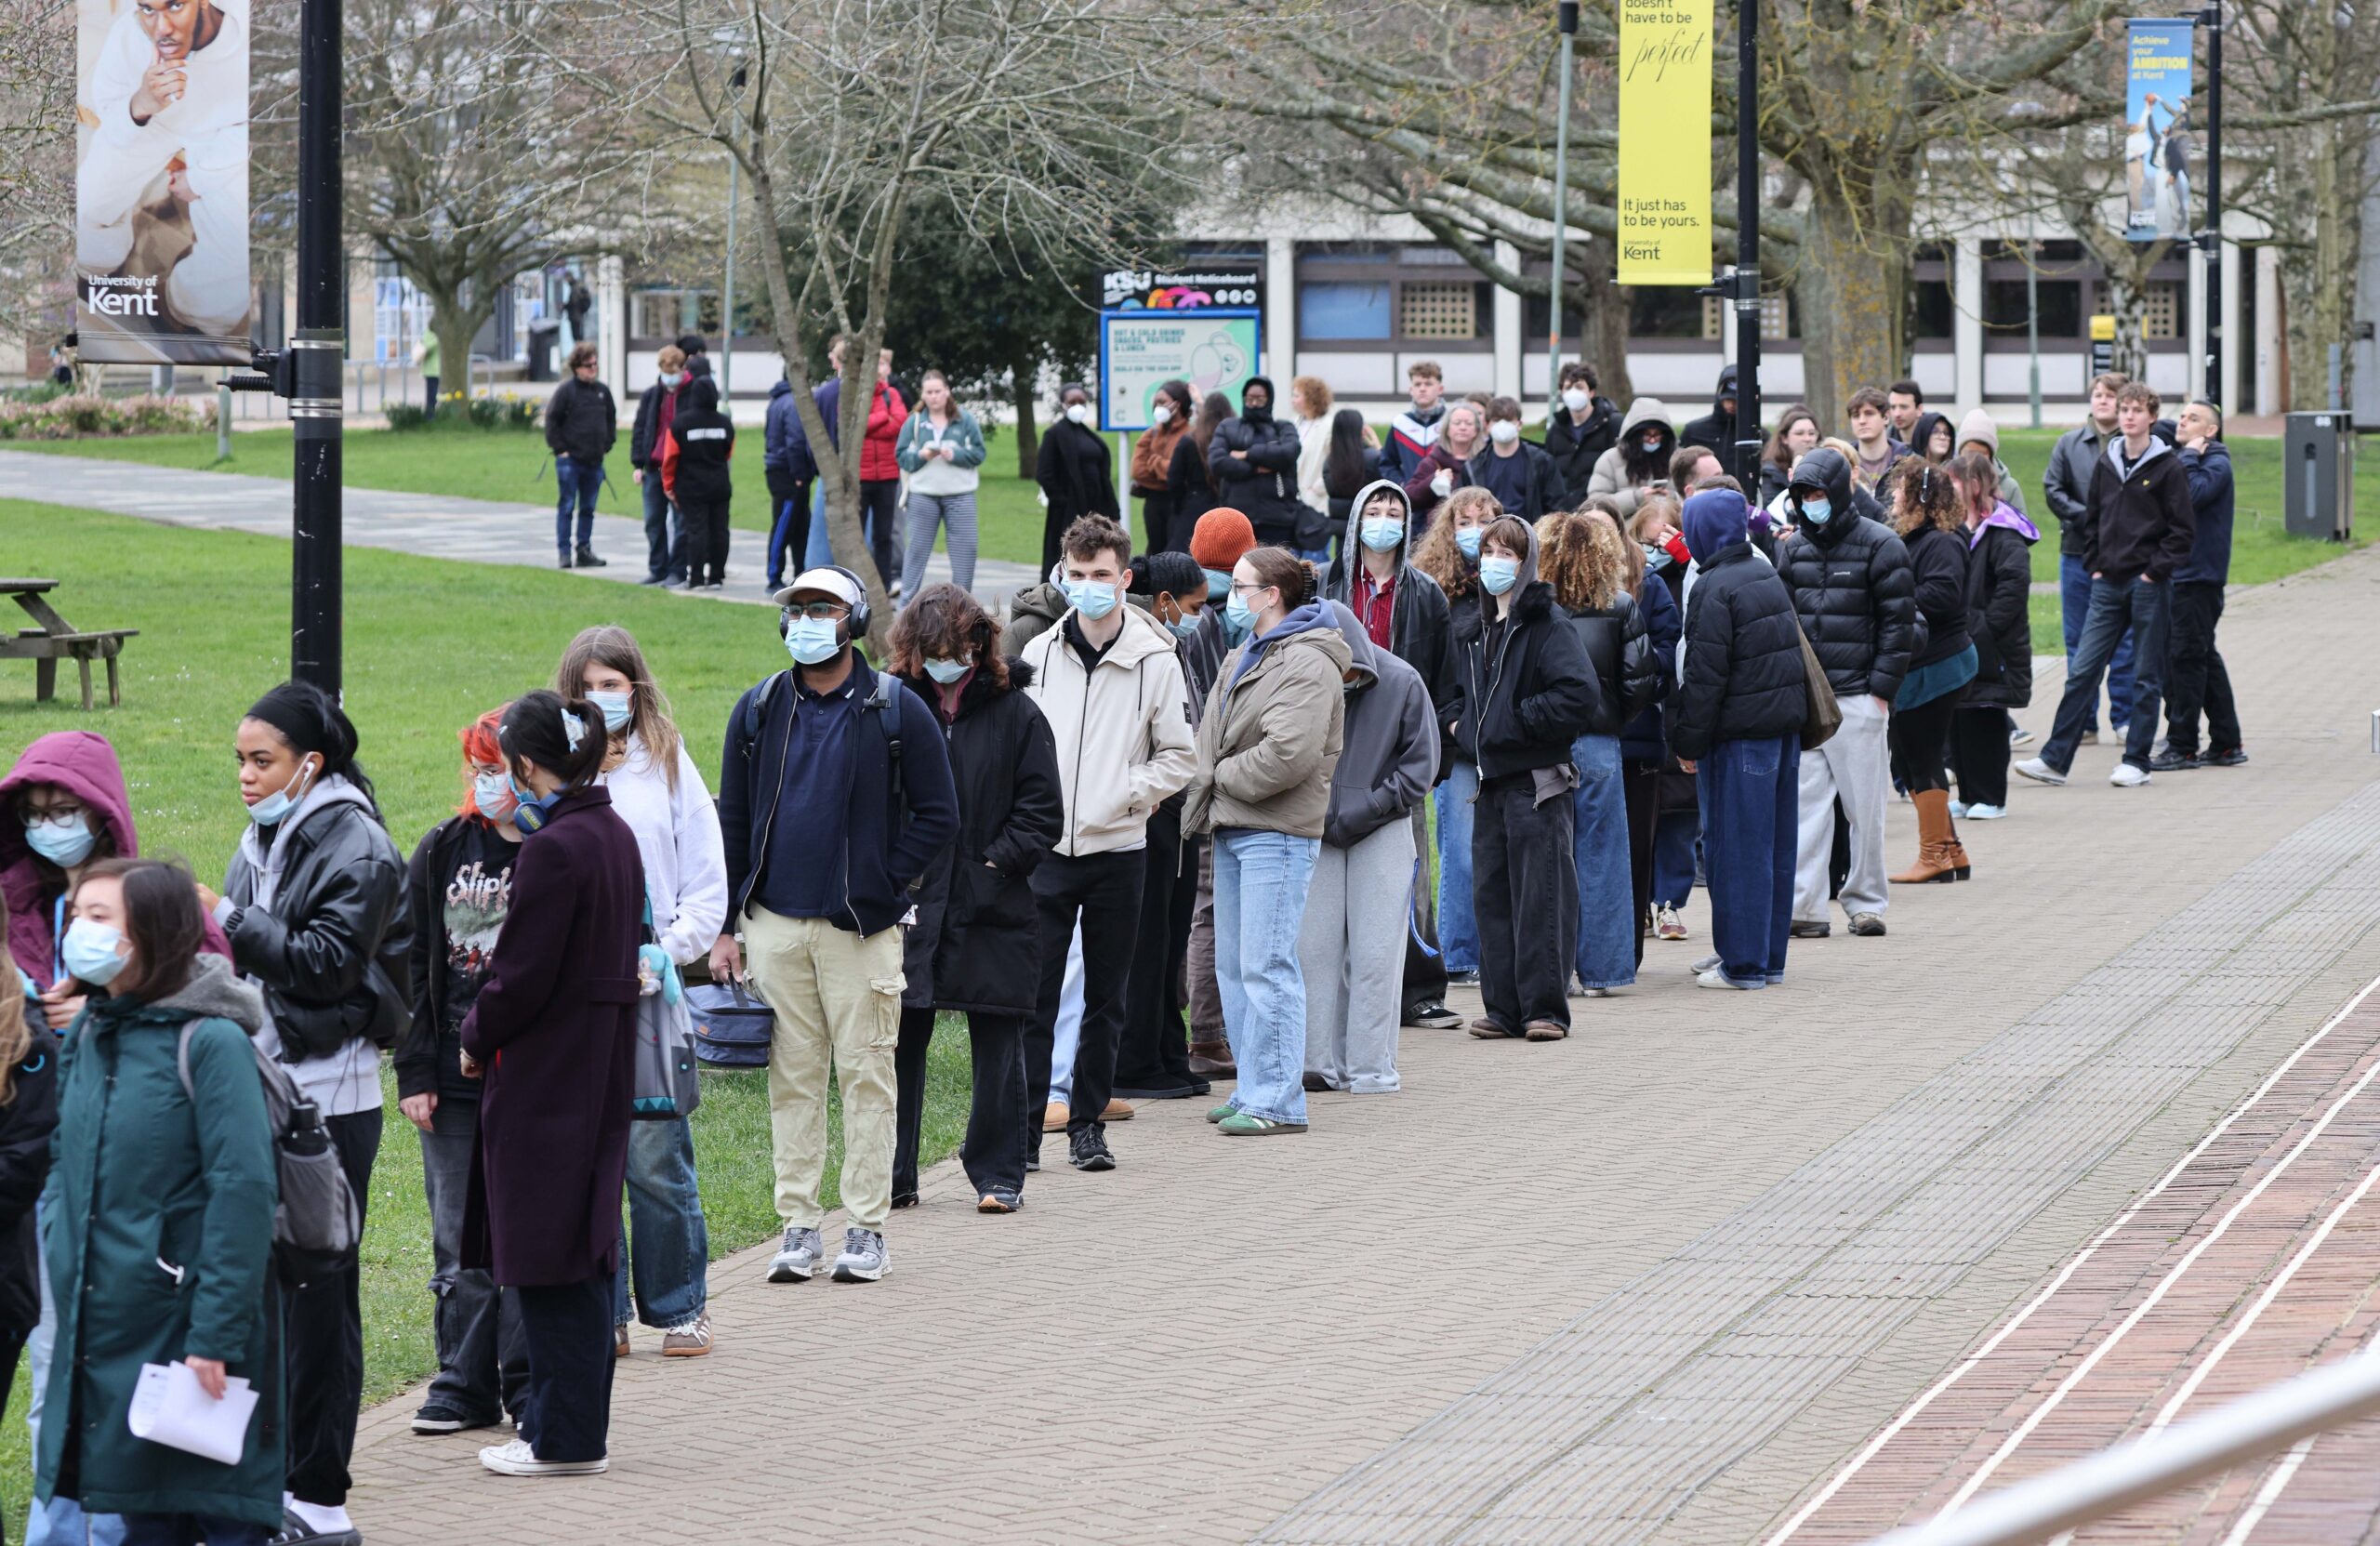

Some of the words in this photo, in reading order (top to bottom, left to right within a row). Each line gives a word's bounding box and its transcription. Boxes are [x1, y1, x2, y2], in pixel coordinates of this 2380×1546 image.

[1625, 0, 1673, 8] doesnt
[1625, 11, 1657, 23] have
[1659, 11, 1673, 23] to
[1676, 11, 1692, 23] be
[2132, 35, 2170, 46] Achieve
[1626, 27, 1705, 83] perfect
[2132, 56, 2188, 70] AMBITION
[1623, 198, 1633, 211] It
[1635, 198, 1660, 214] just
[1663, 198, 1687, 211] has
[1623, 214, 1637, 226] to
[1640, 214, 1657, 226] be
[1659, 217, 1700, 230] yours.
[1623, 245, 1661, 260] Kent
[87, 274, 144, 290] University
[145, 274, 158, 287] of
[1104, 270, 1152, 291] KSU
[1155, 274, 1195, 285] Student
[1196, 273, 1257, 284] Noticeboard
[87, 286, 159, 316] Kent
[446, 861, 512, 912] Slipk
